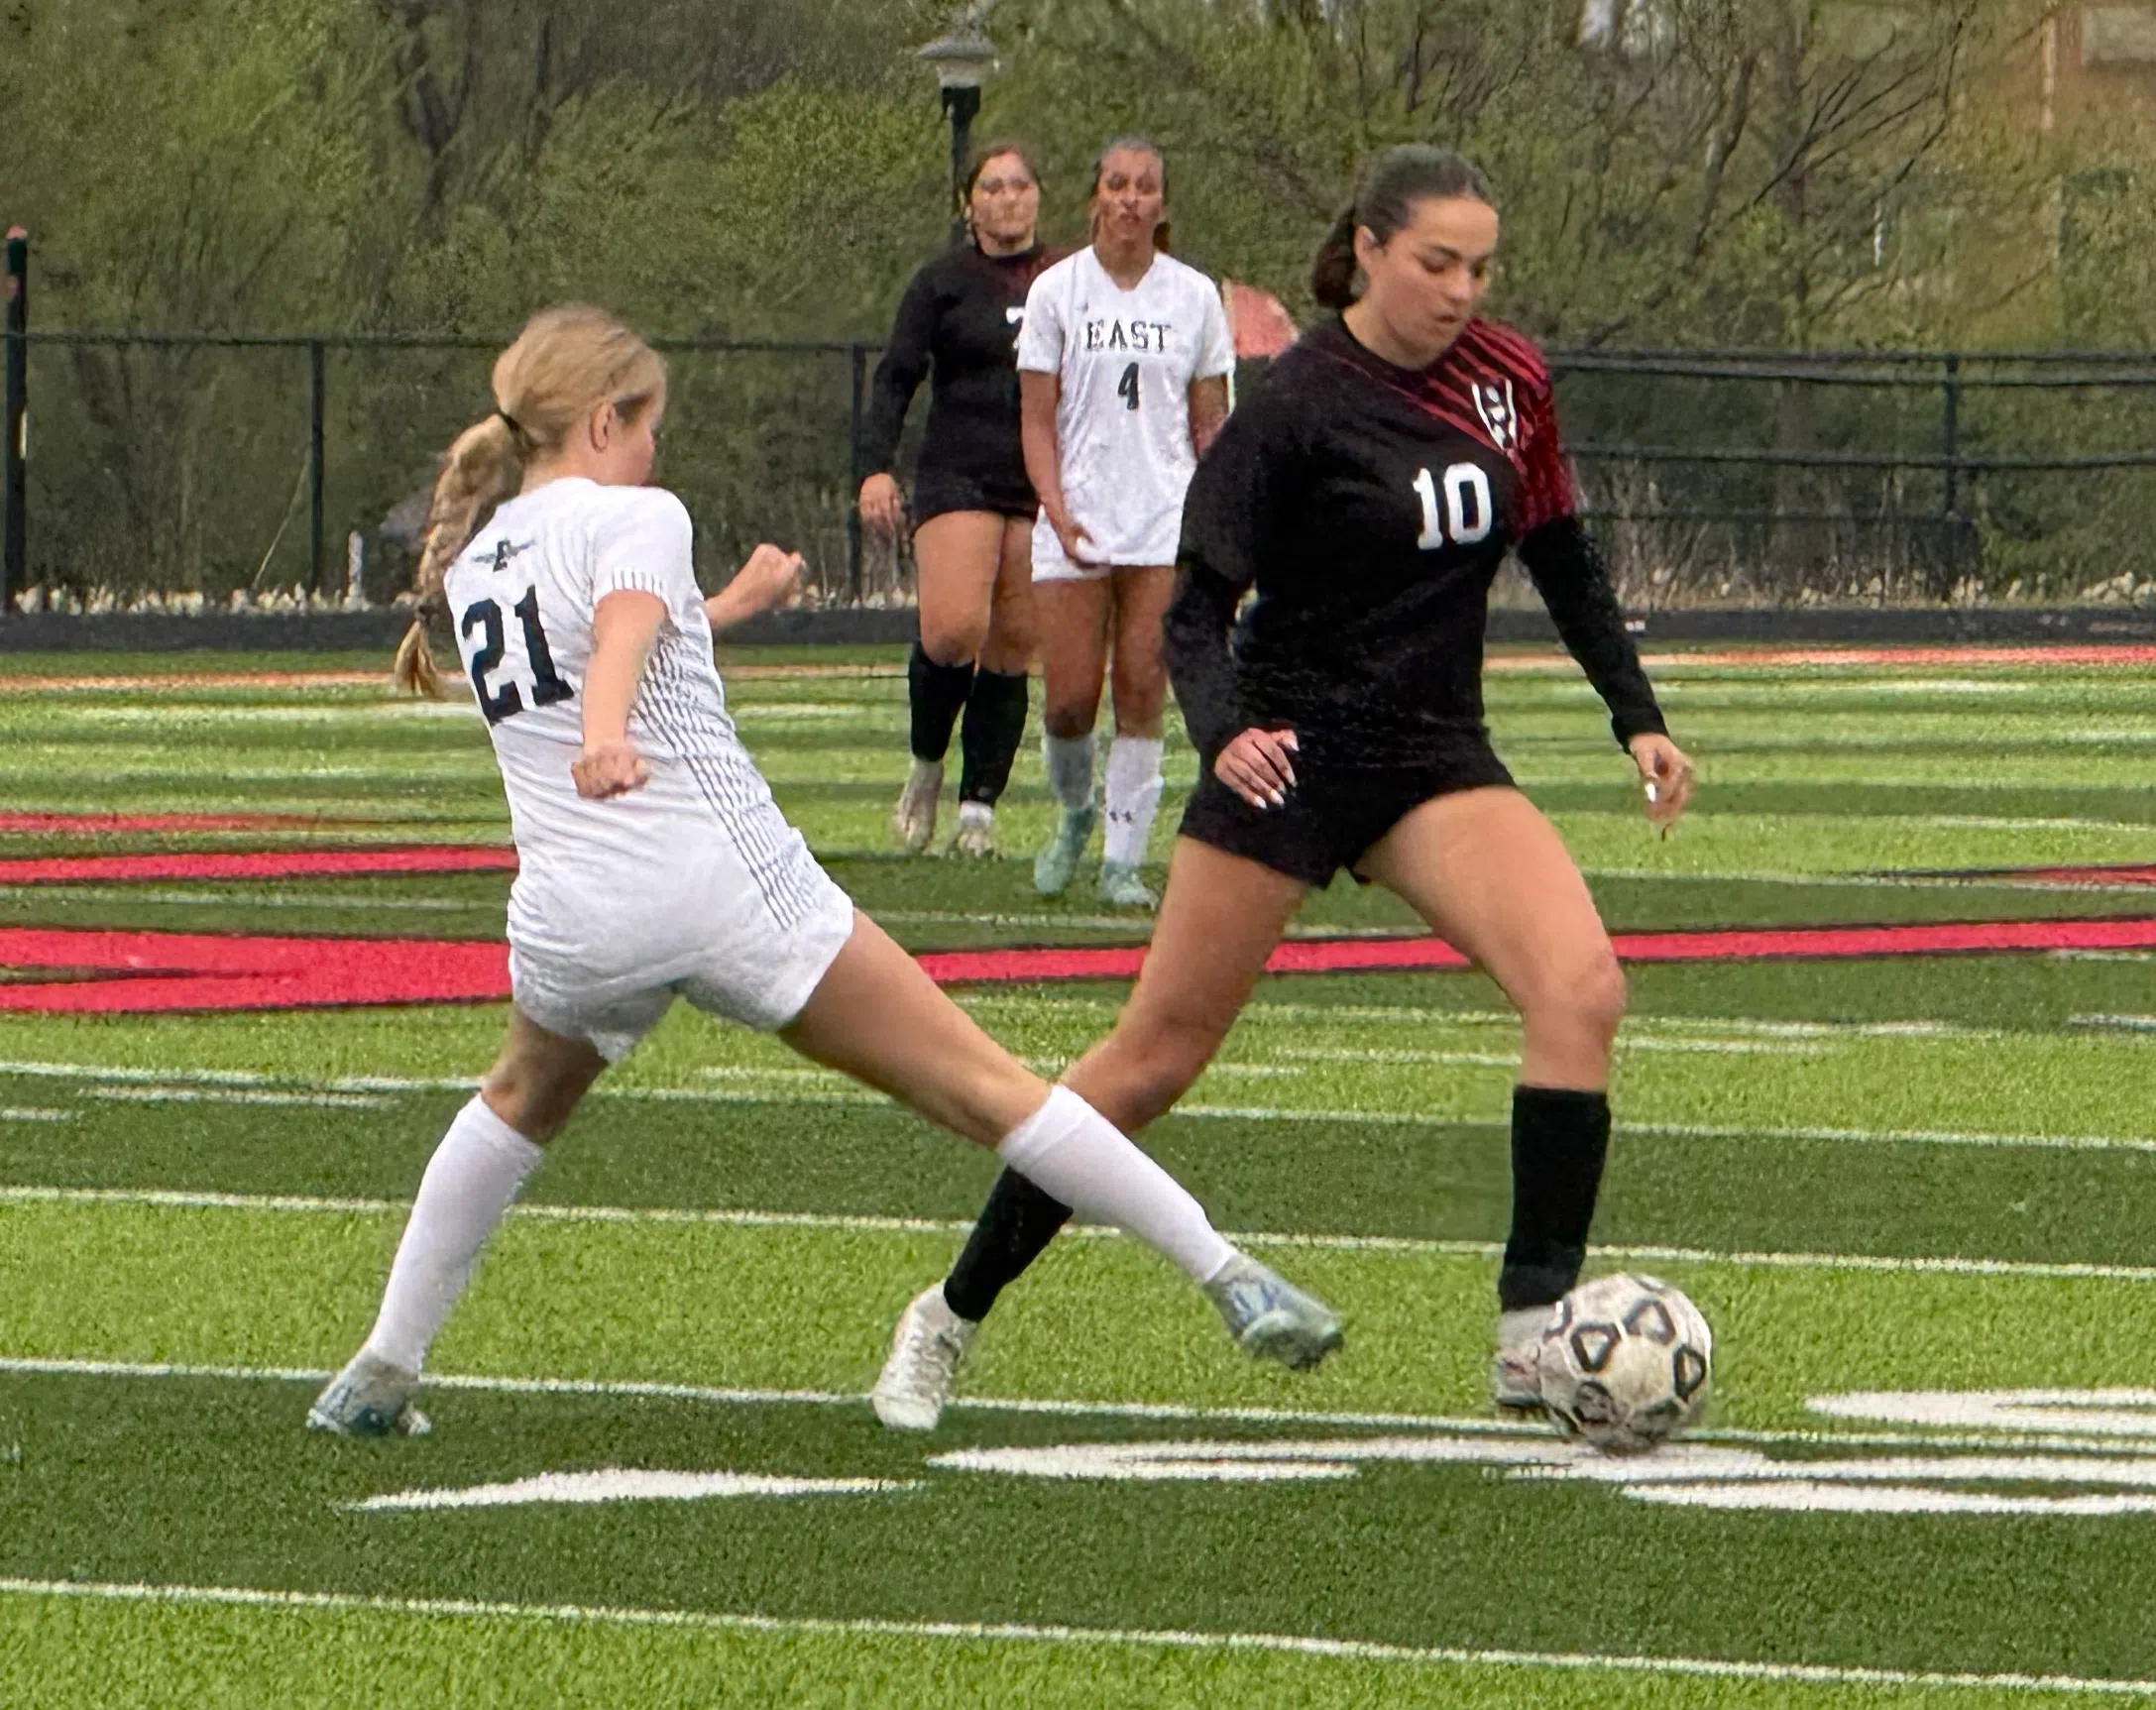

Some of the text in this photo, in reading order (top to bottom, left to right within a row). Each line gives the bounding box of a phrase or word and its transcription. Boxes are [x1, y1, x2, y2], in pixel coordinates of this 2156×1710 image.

[1086, 318, 1171, 352] EAST
[1117, 361, 1139, 410] 4
[1412, 462, 1493, 549] 10
[461, 584, 575, 726] 21
